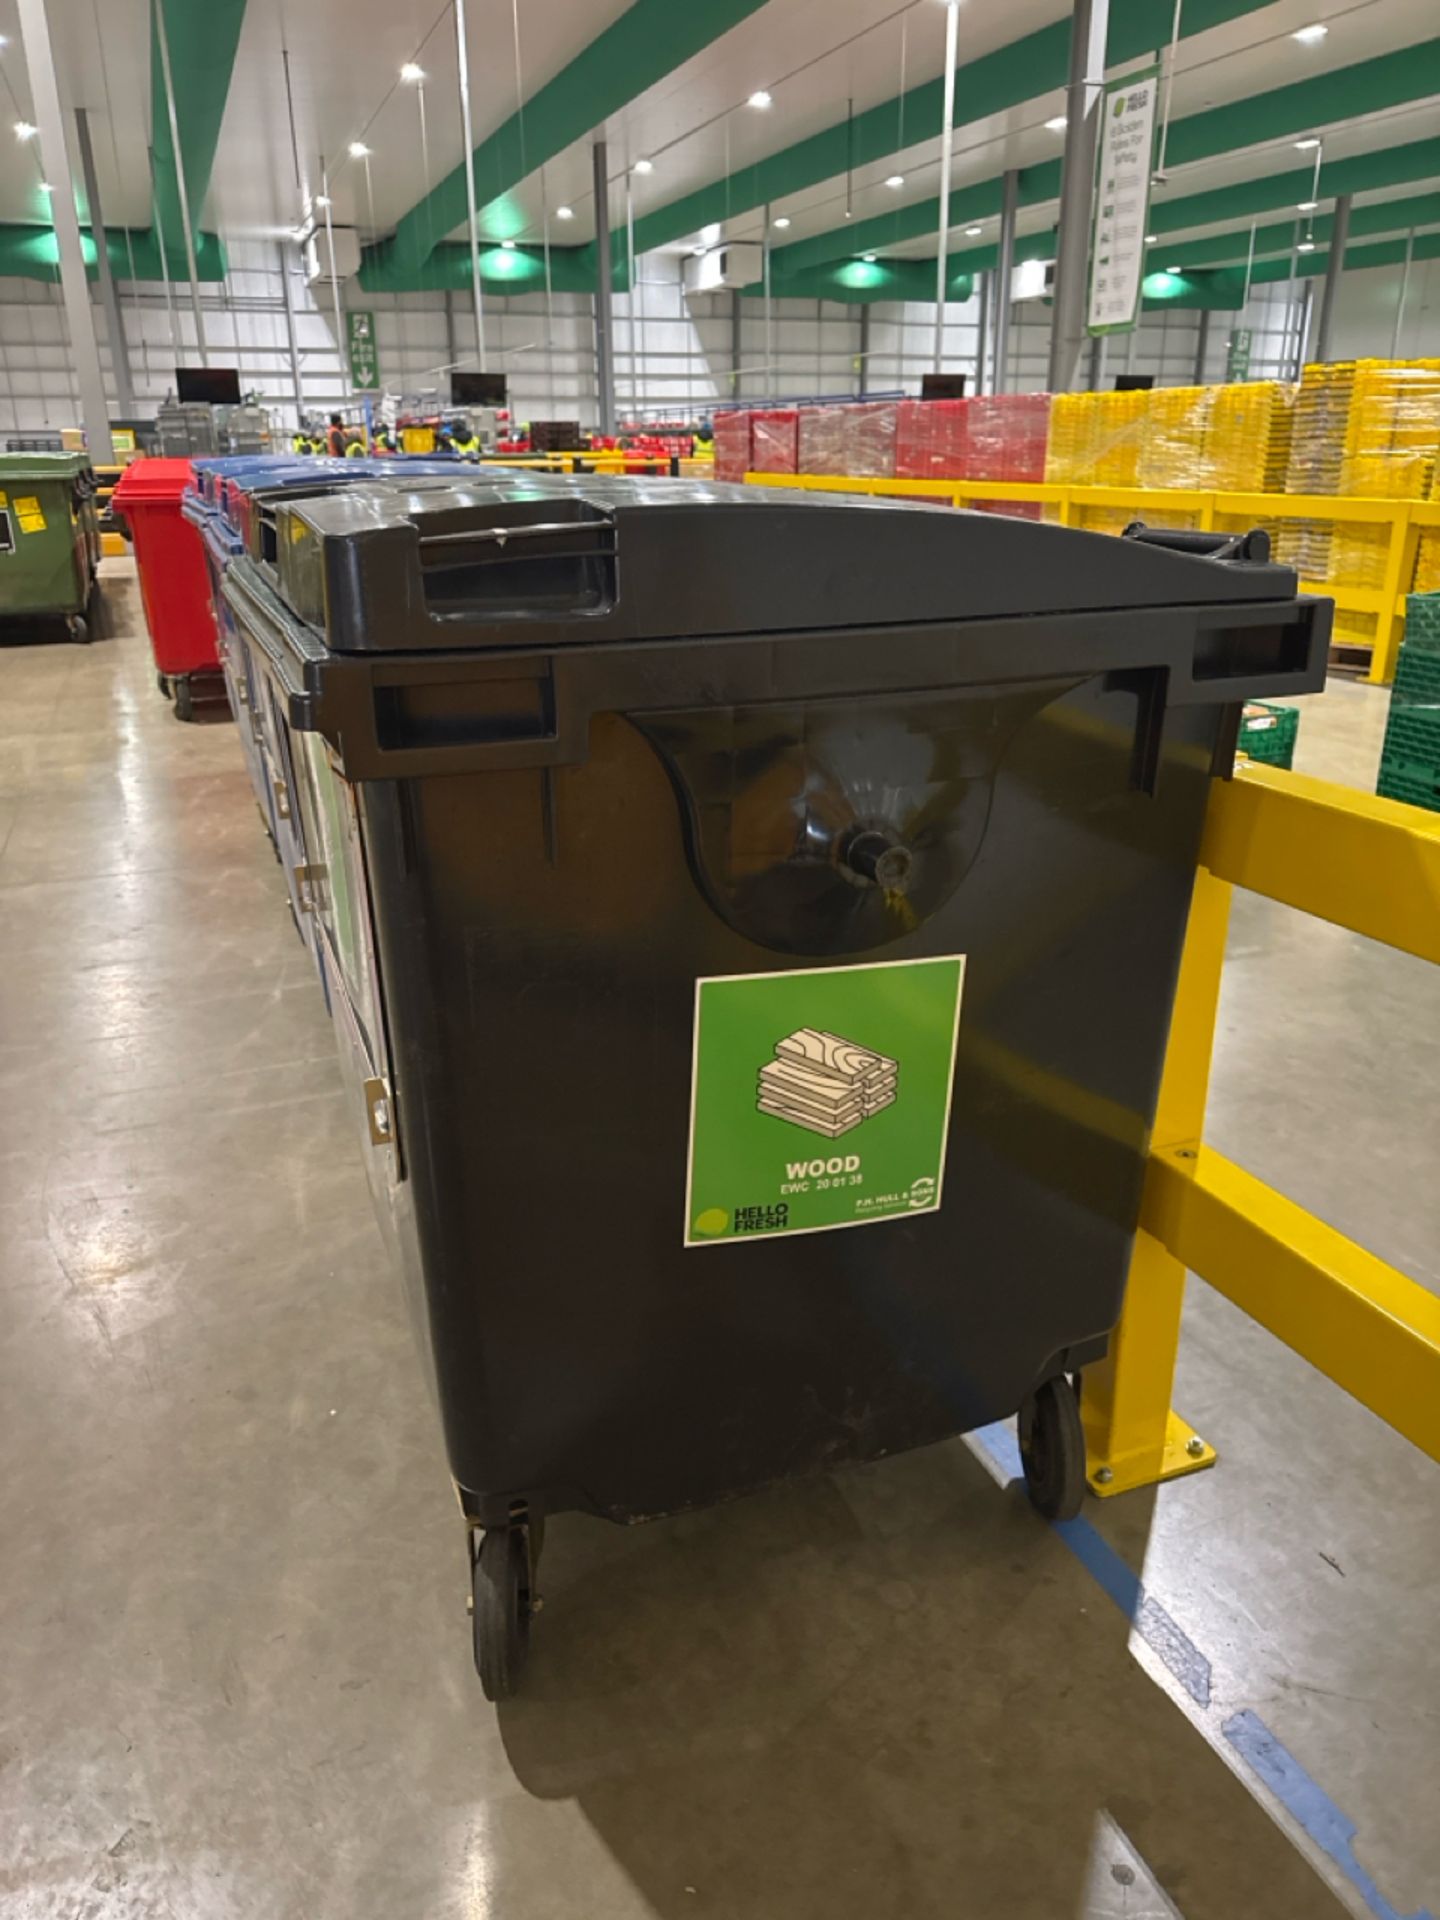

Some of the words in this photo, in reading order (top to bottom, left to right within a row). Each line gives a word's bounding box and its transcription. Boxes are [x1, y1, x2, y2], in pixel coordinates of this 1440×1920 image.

[785, 1155, 861, 1180] WOOD
[780, 1181, 810, 1195] EWC
[816, 1178, 829, 1190] 20
[734, 1203, 789, 1219] HELLO
[734, 1215, 788, 1233] FRESH
